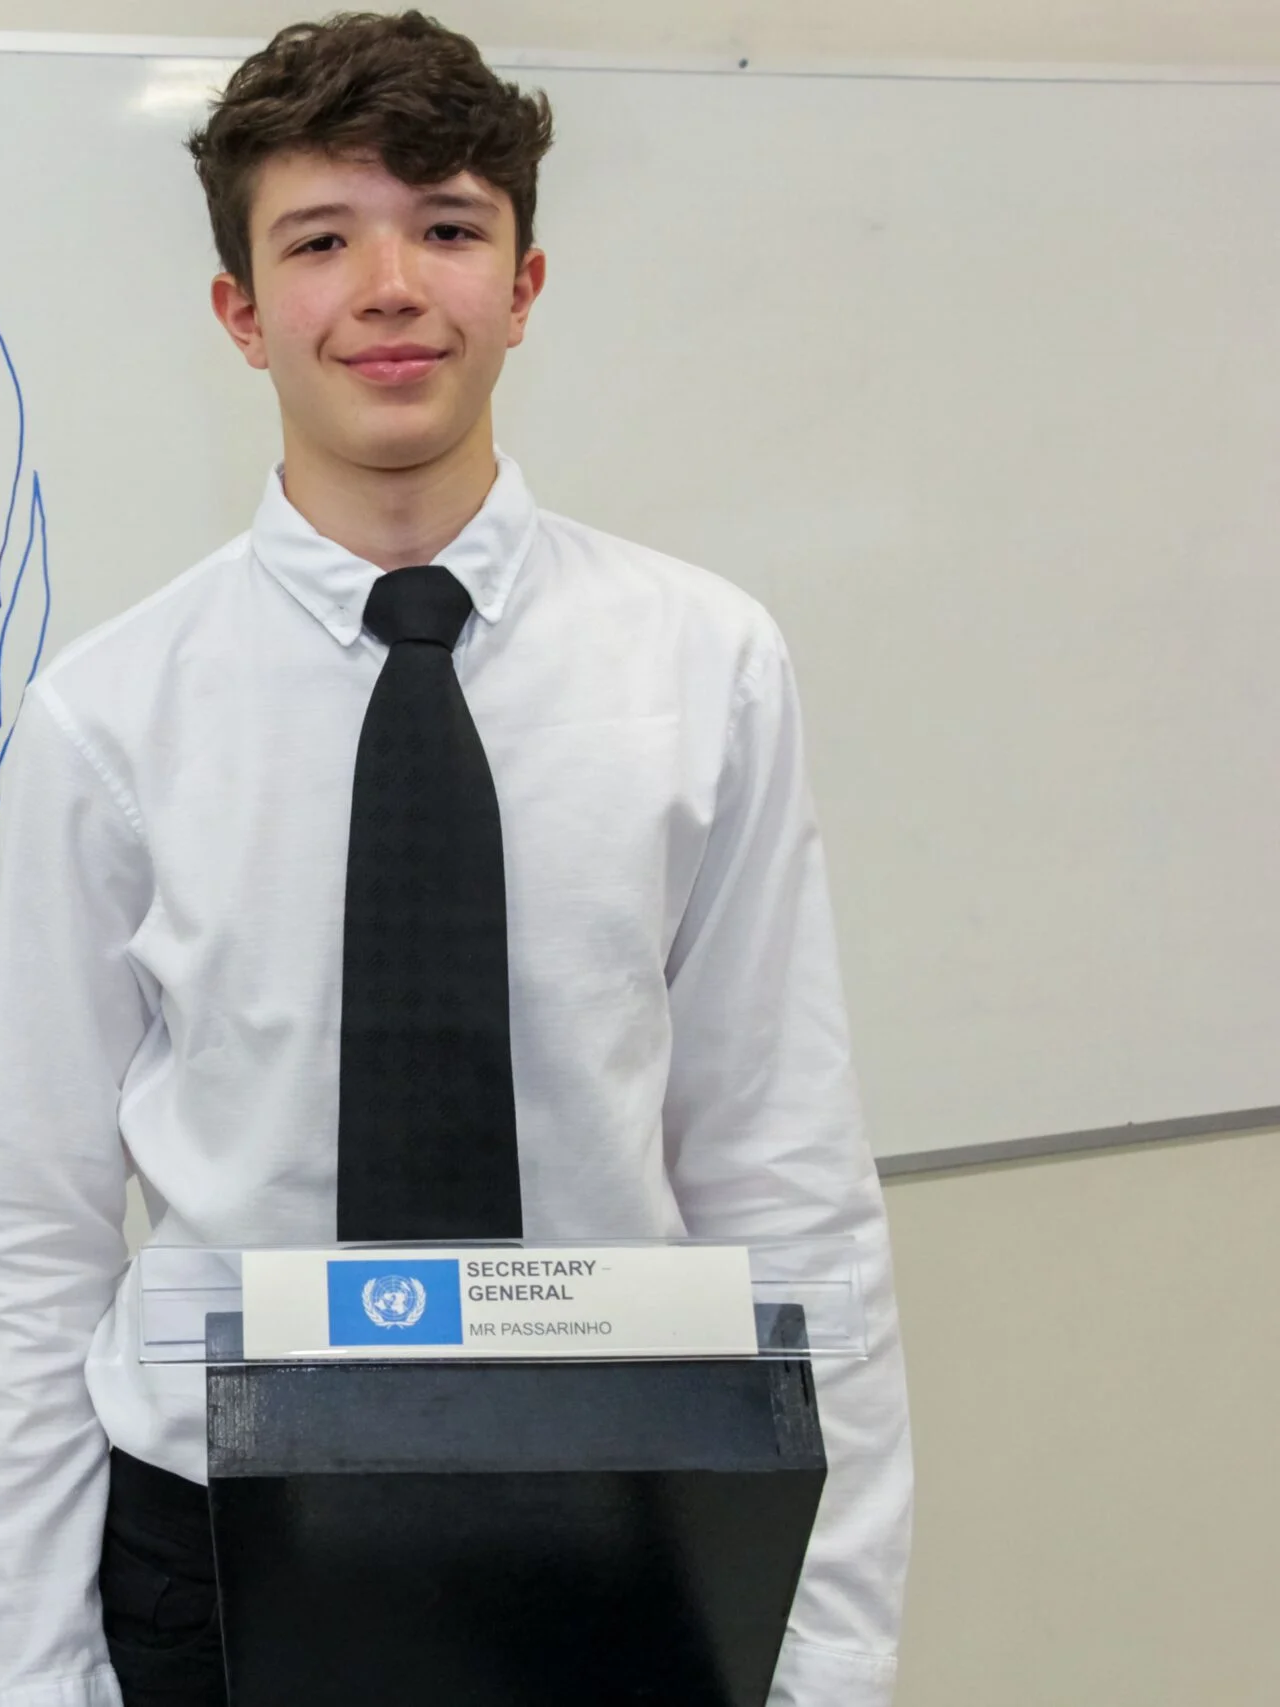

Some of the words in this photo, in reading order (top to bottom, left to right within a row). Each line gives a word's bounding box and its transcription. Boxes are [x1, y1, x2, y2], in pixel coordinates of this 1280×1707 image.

[467, 1260, 596, 1277] SECRETARY
[468, 1285, 574, 1301] GENERAL
[470, 1322, 496, 1336] MR
[500, 1321, 613, 1336] PASSARINHO
